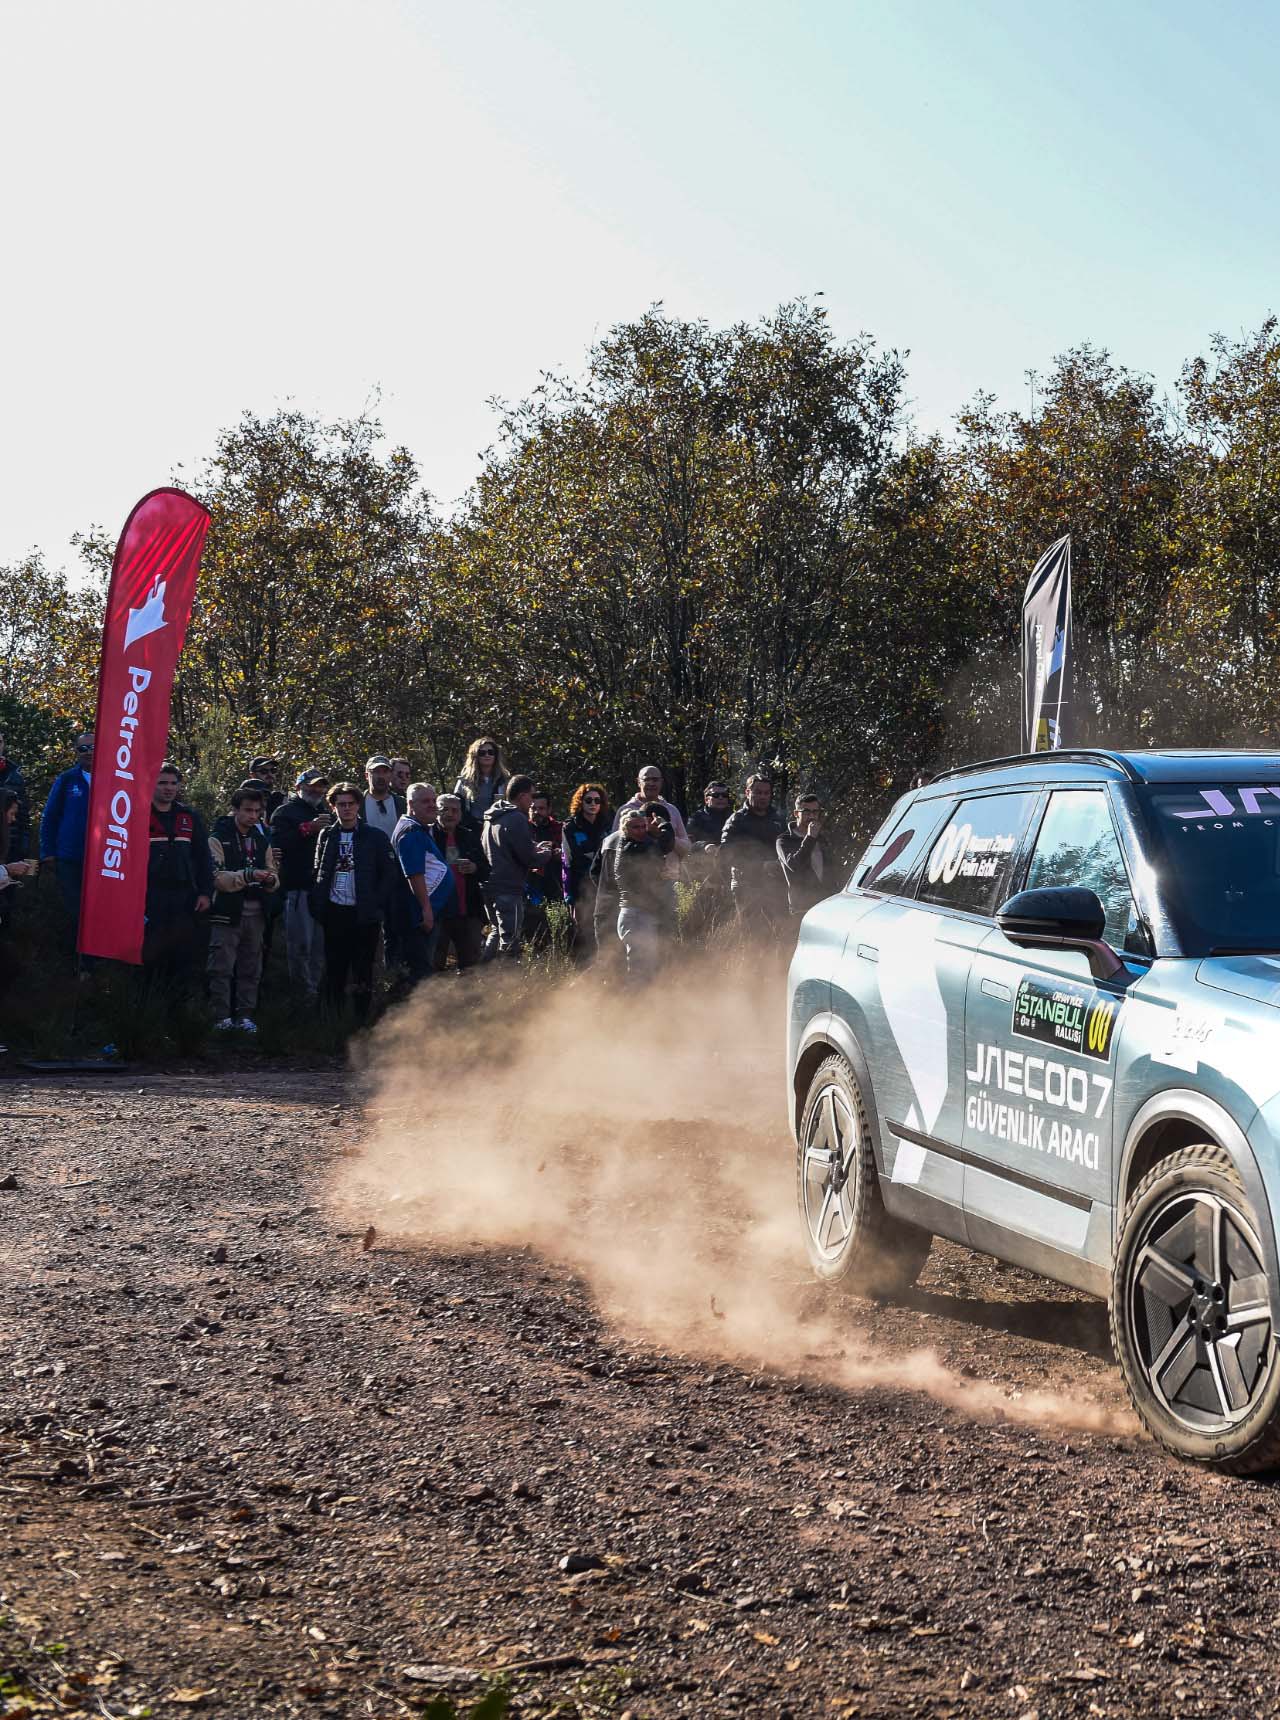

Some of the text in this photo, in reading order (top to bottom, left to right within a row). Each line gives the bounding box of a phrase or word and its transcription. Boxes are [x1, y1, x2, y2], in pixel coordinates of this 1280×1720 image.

[101, 666, 152, 881] Petrol Ofisi
[928, 824, 972, 884] 00
[1182, 821, 1244, 833] FROM
[1088, 999, 1115, 1053] 00
[966, 1089, 1099, 1170] GÜVENLİK ARACI
